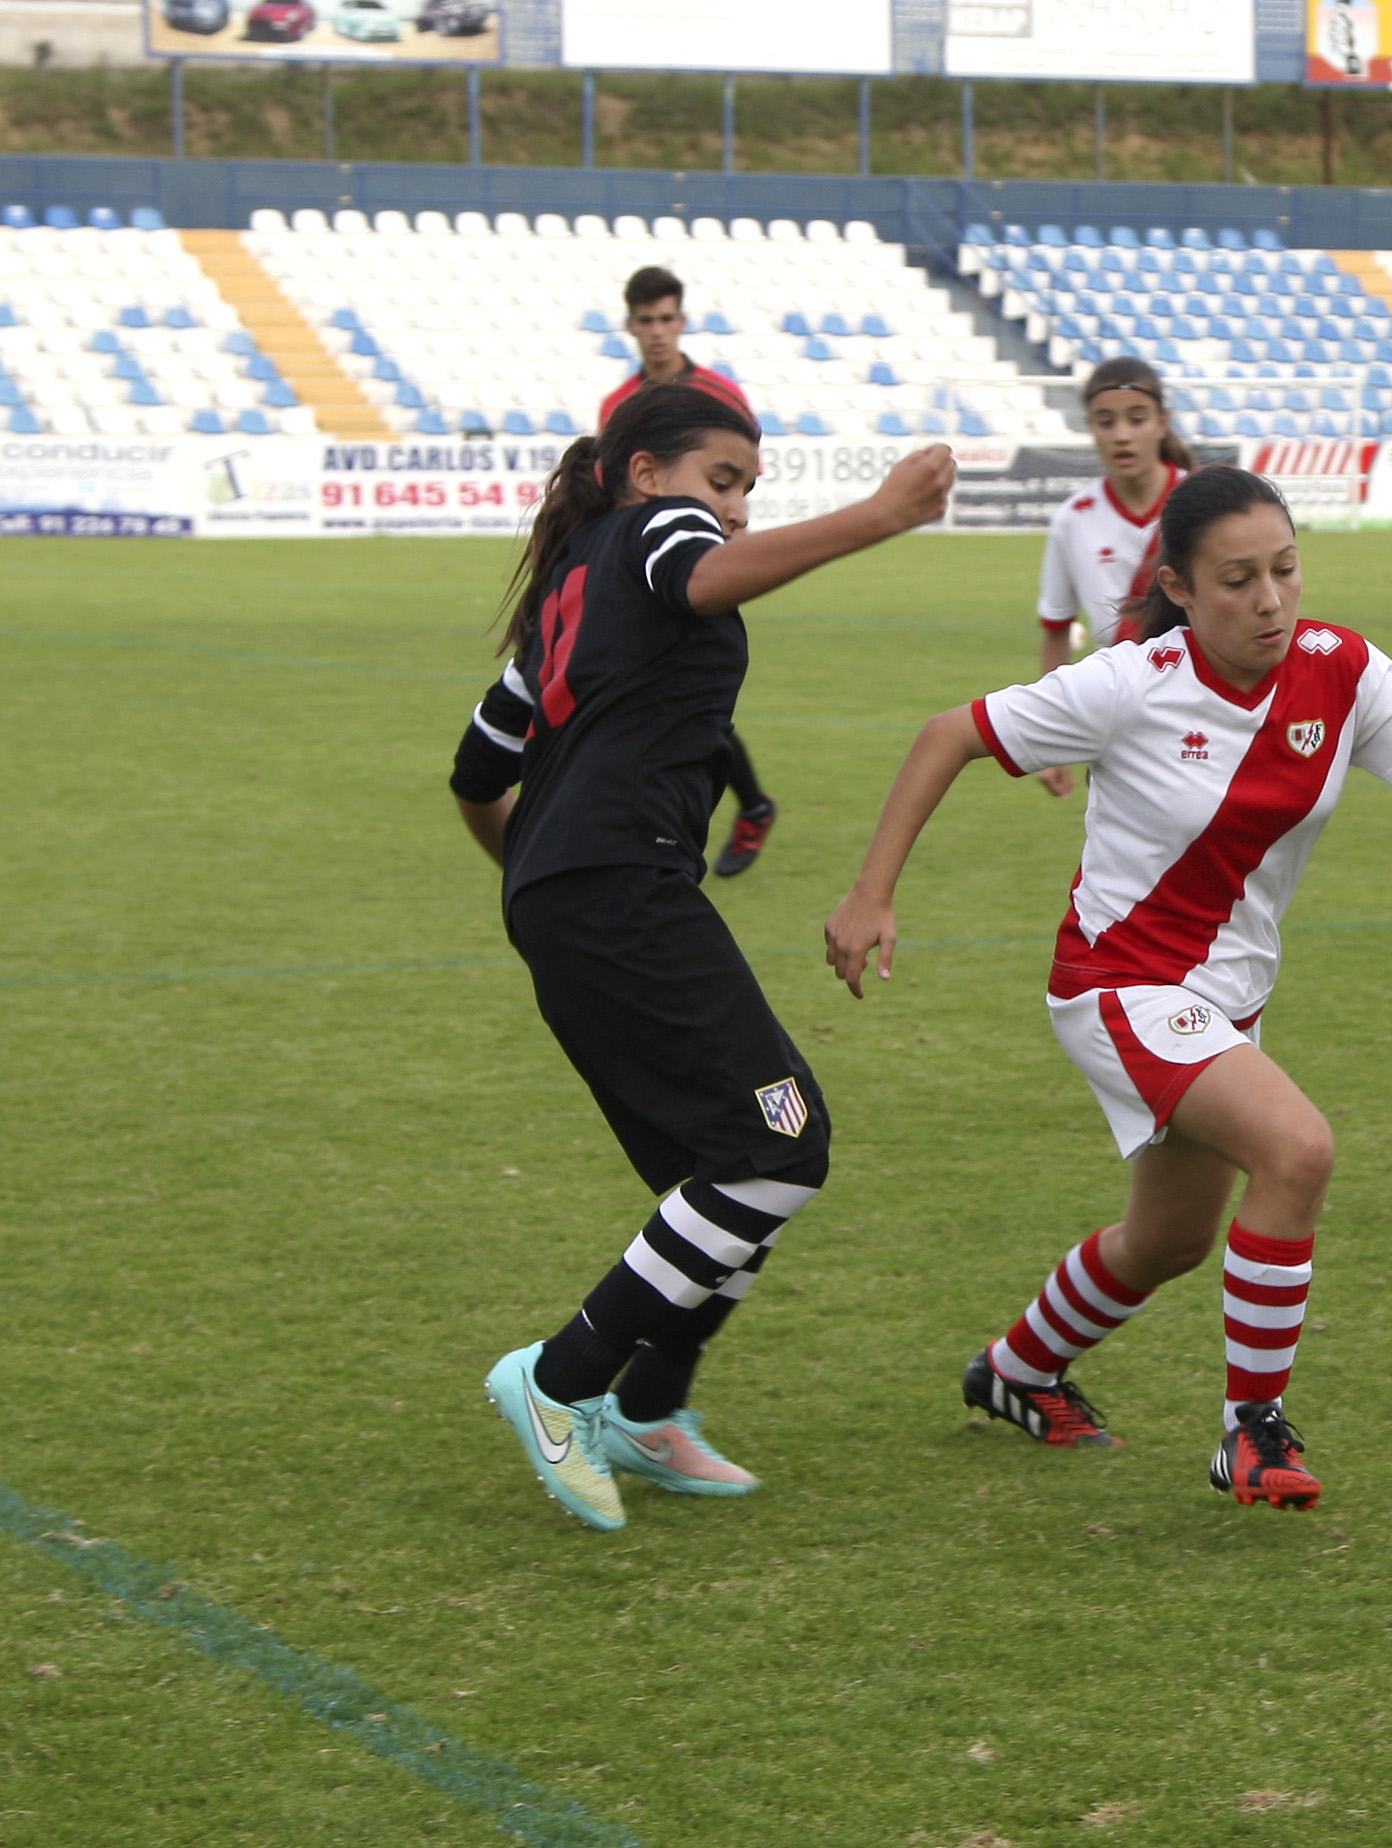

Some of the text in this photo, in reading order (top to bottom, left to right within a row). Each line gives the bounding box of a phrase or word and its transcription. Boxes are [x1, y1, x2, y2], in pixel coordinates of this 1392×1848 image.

[2, 441, 176, 463] conducir
[321, 480, 362, 508] 91
[373, 480, 446, 508] 645
[458, 480, 504, 508] 54
